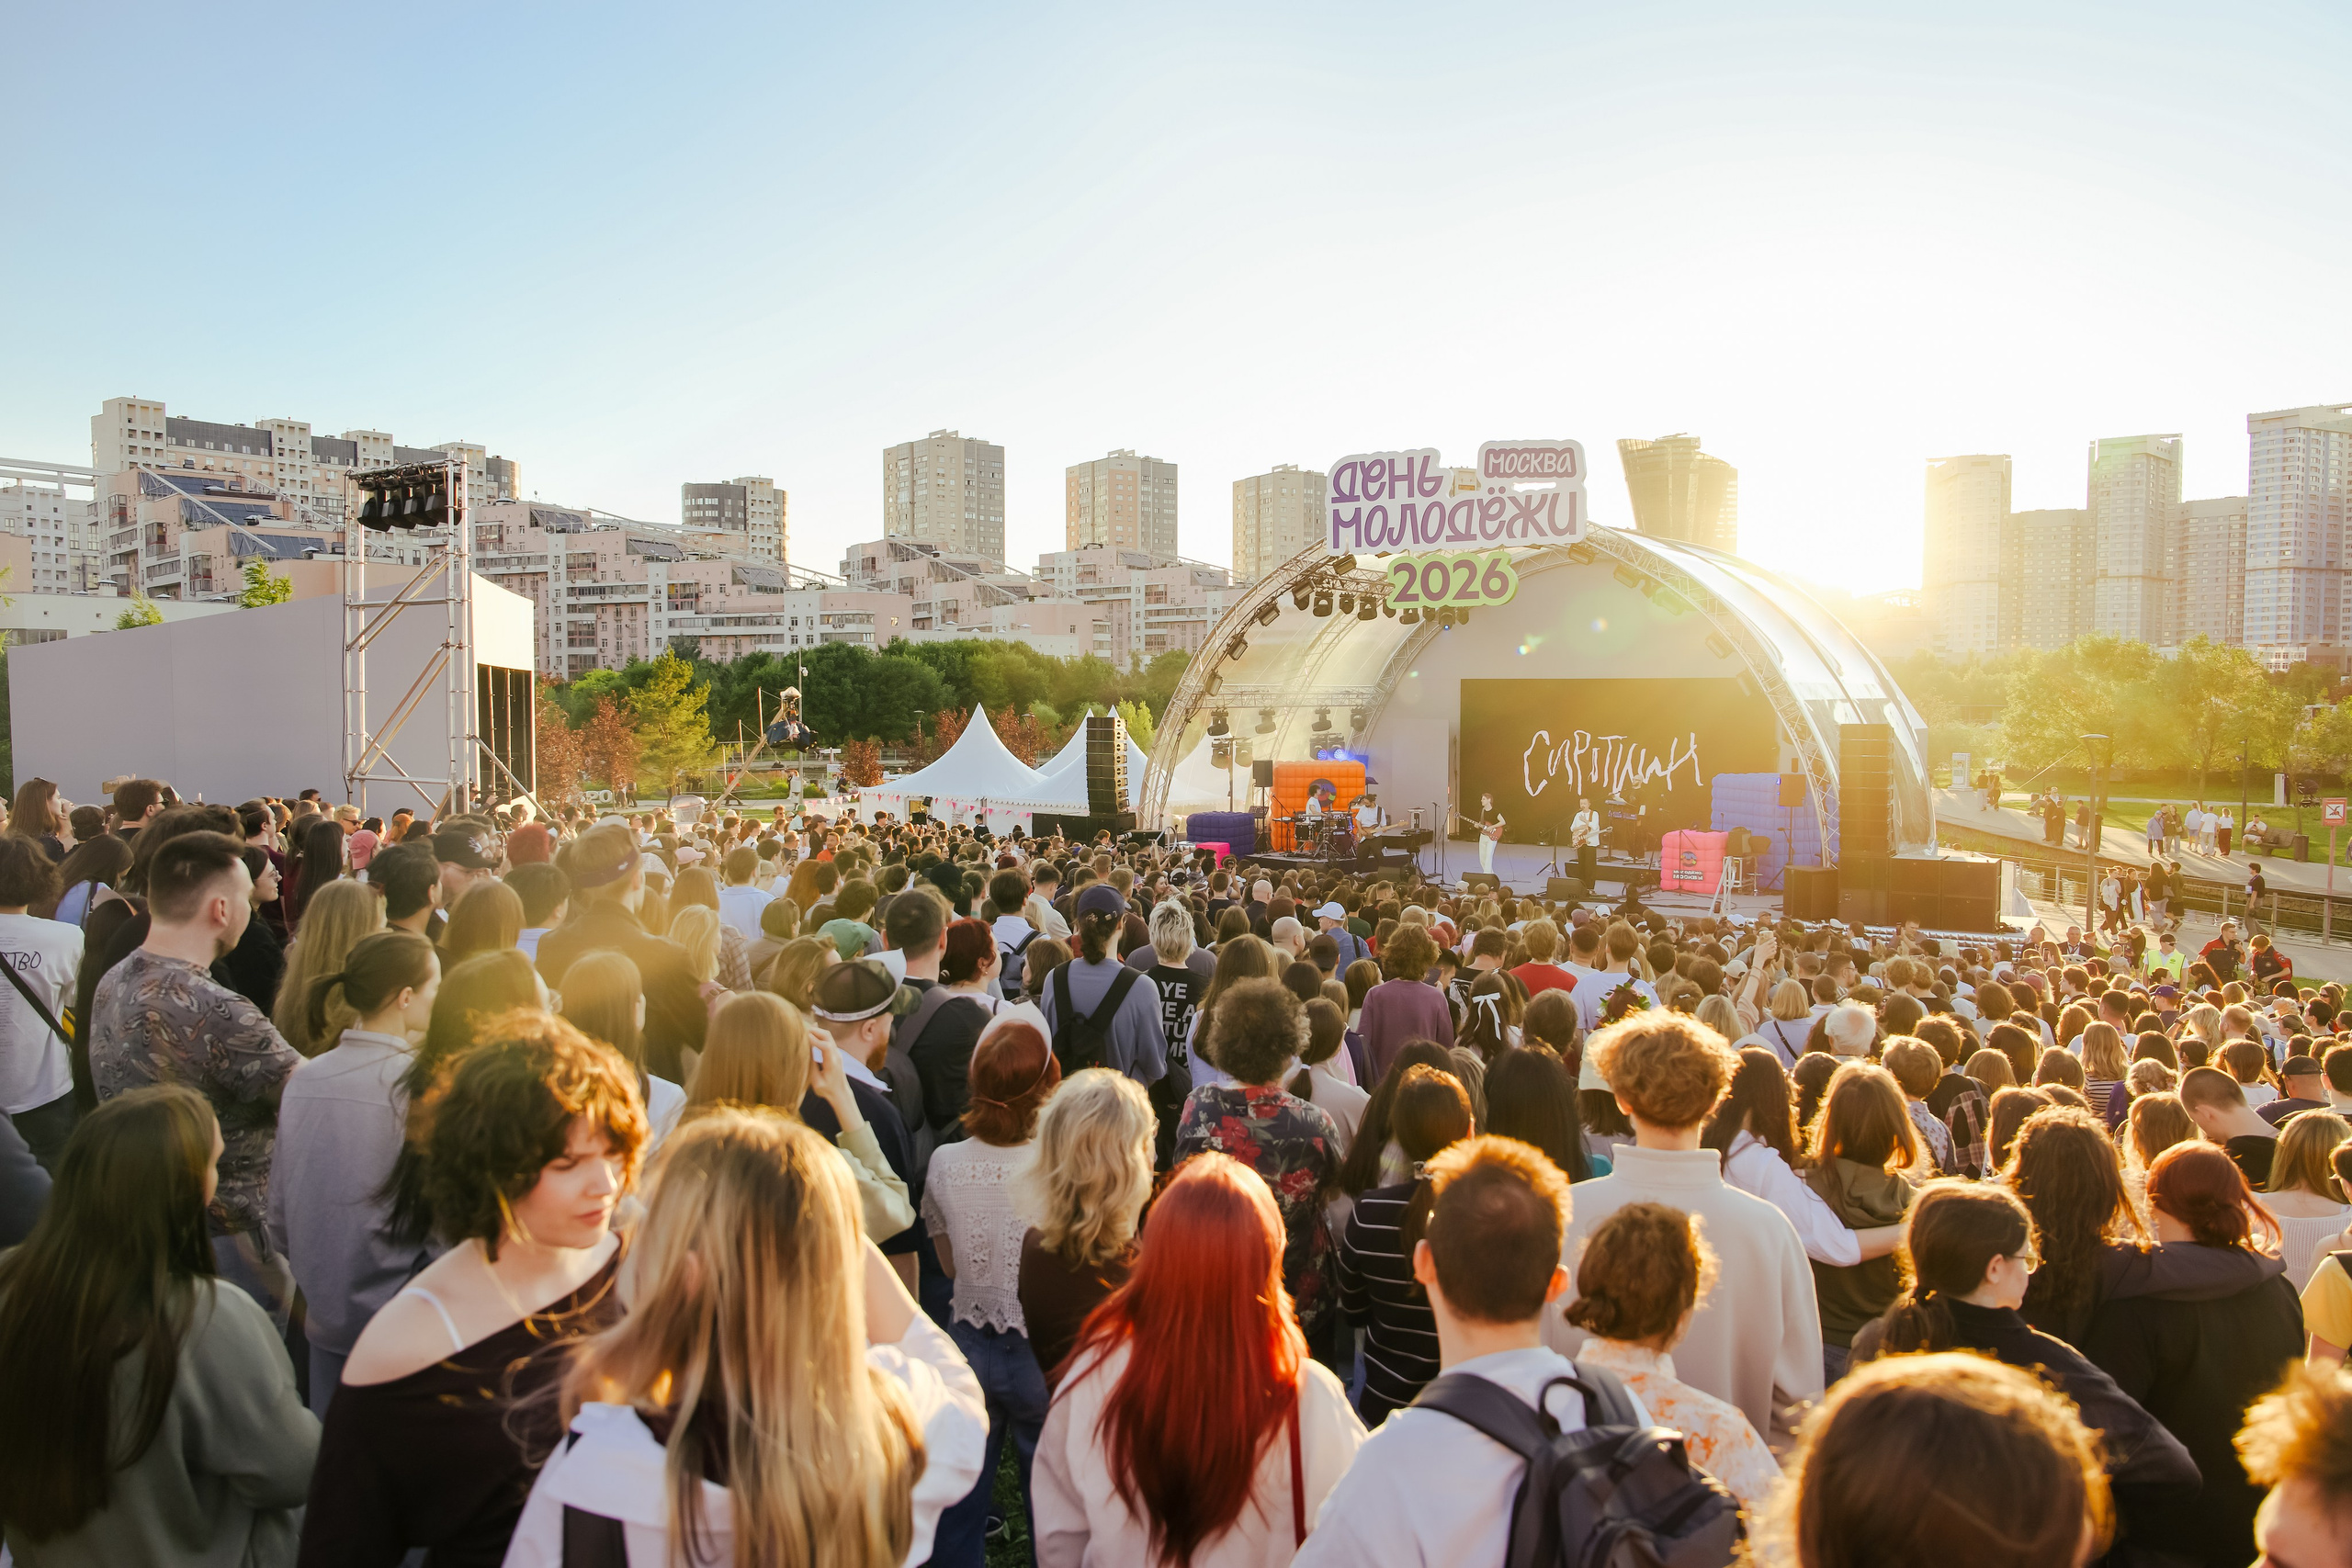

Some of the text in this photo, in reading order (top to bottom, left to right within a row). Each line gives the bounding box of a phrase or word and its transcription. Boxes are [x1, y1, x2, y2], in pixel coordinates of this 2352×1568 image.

[1331, 455, 1443, 503] ДЕНЬ
[1487, 453, 1572, 474] МОСКВА
[1332, 486, 1577, 549] МОЛОДЁЖИ
[1393, 558, 1510, 603] 2026
[1161, 981, 1187, 998] YE
